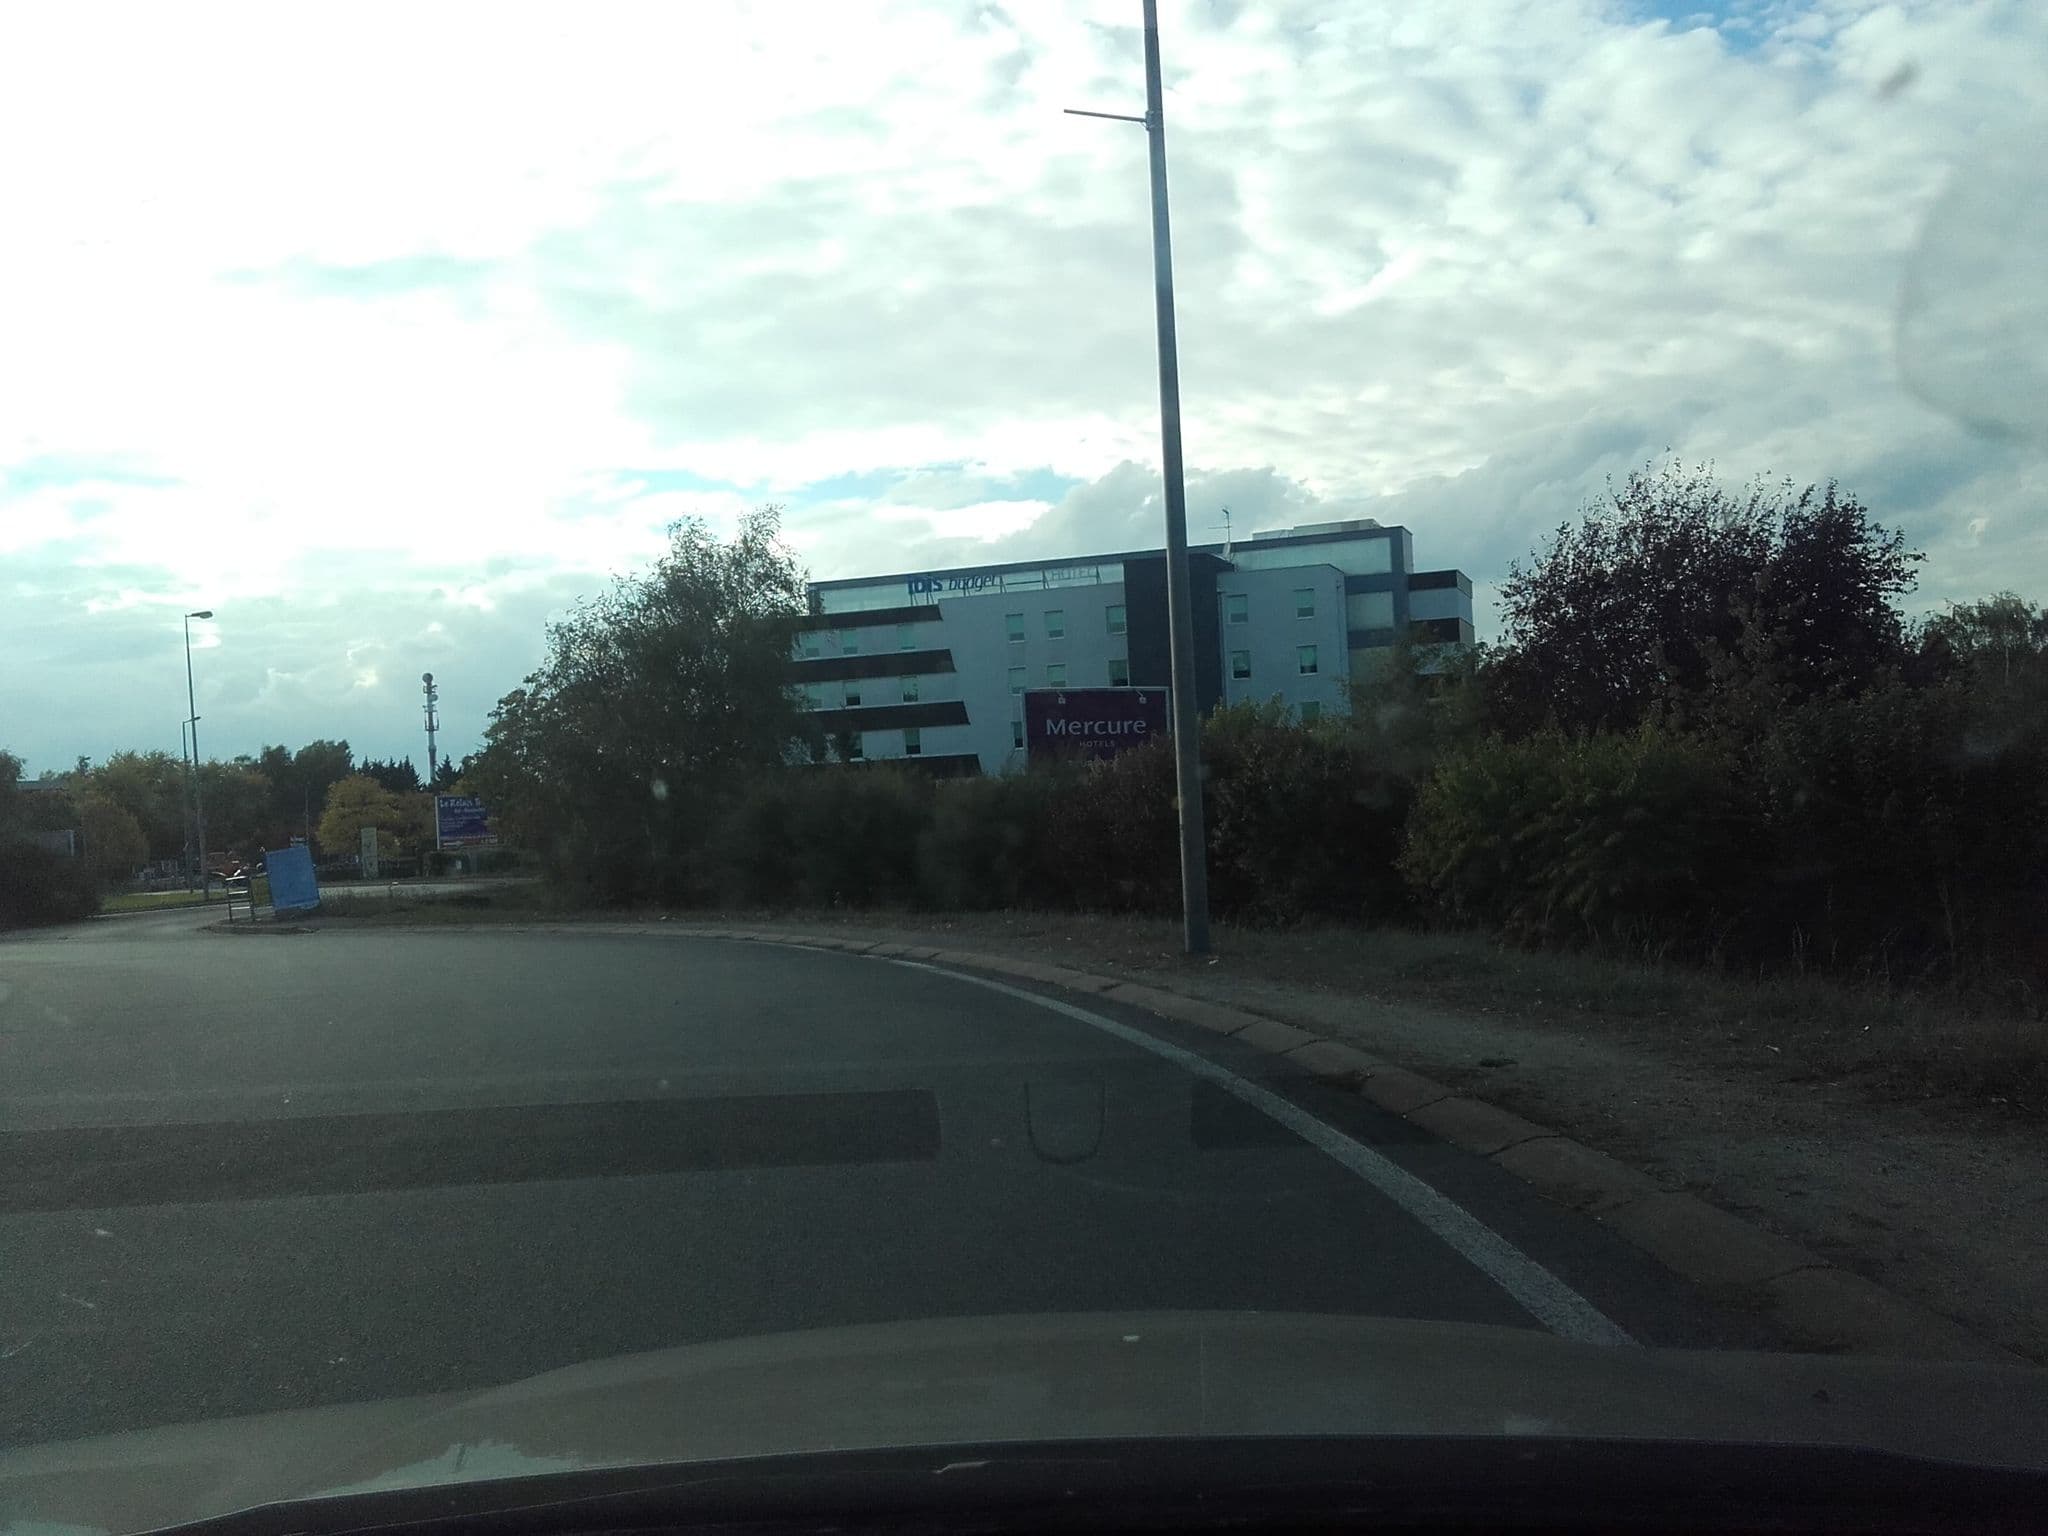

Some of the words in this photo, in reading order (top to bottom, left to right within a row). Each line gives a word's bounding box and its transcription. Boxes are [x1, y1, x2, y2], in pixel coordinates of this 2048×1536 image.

[1051, 567, 1093, 580] HOTEL
[949, 575, 996, 592] budget
[1046, 719, 1147, 735] Mercure
[1079, 739, 1116, 748] HOTELS
